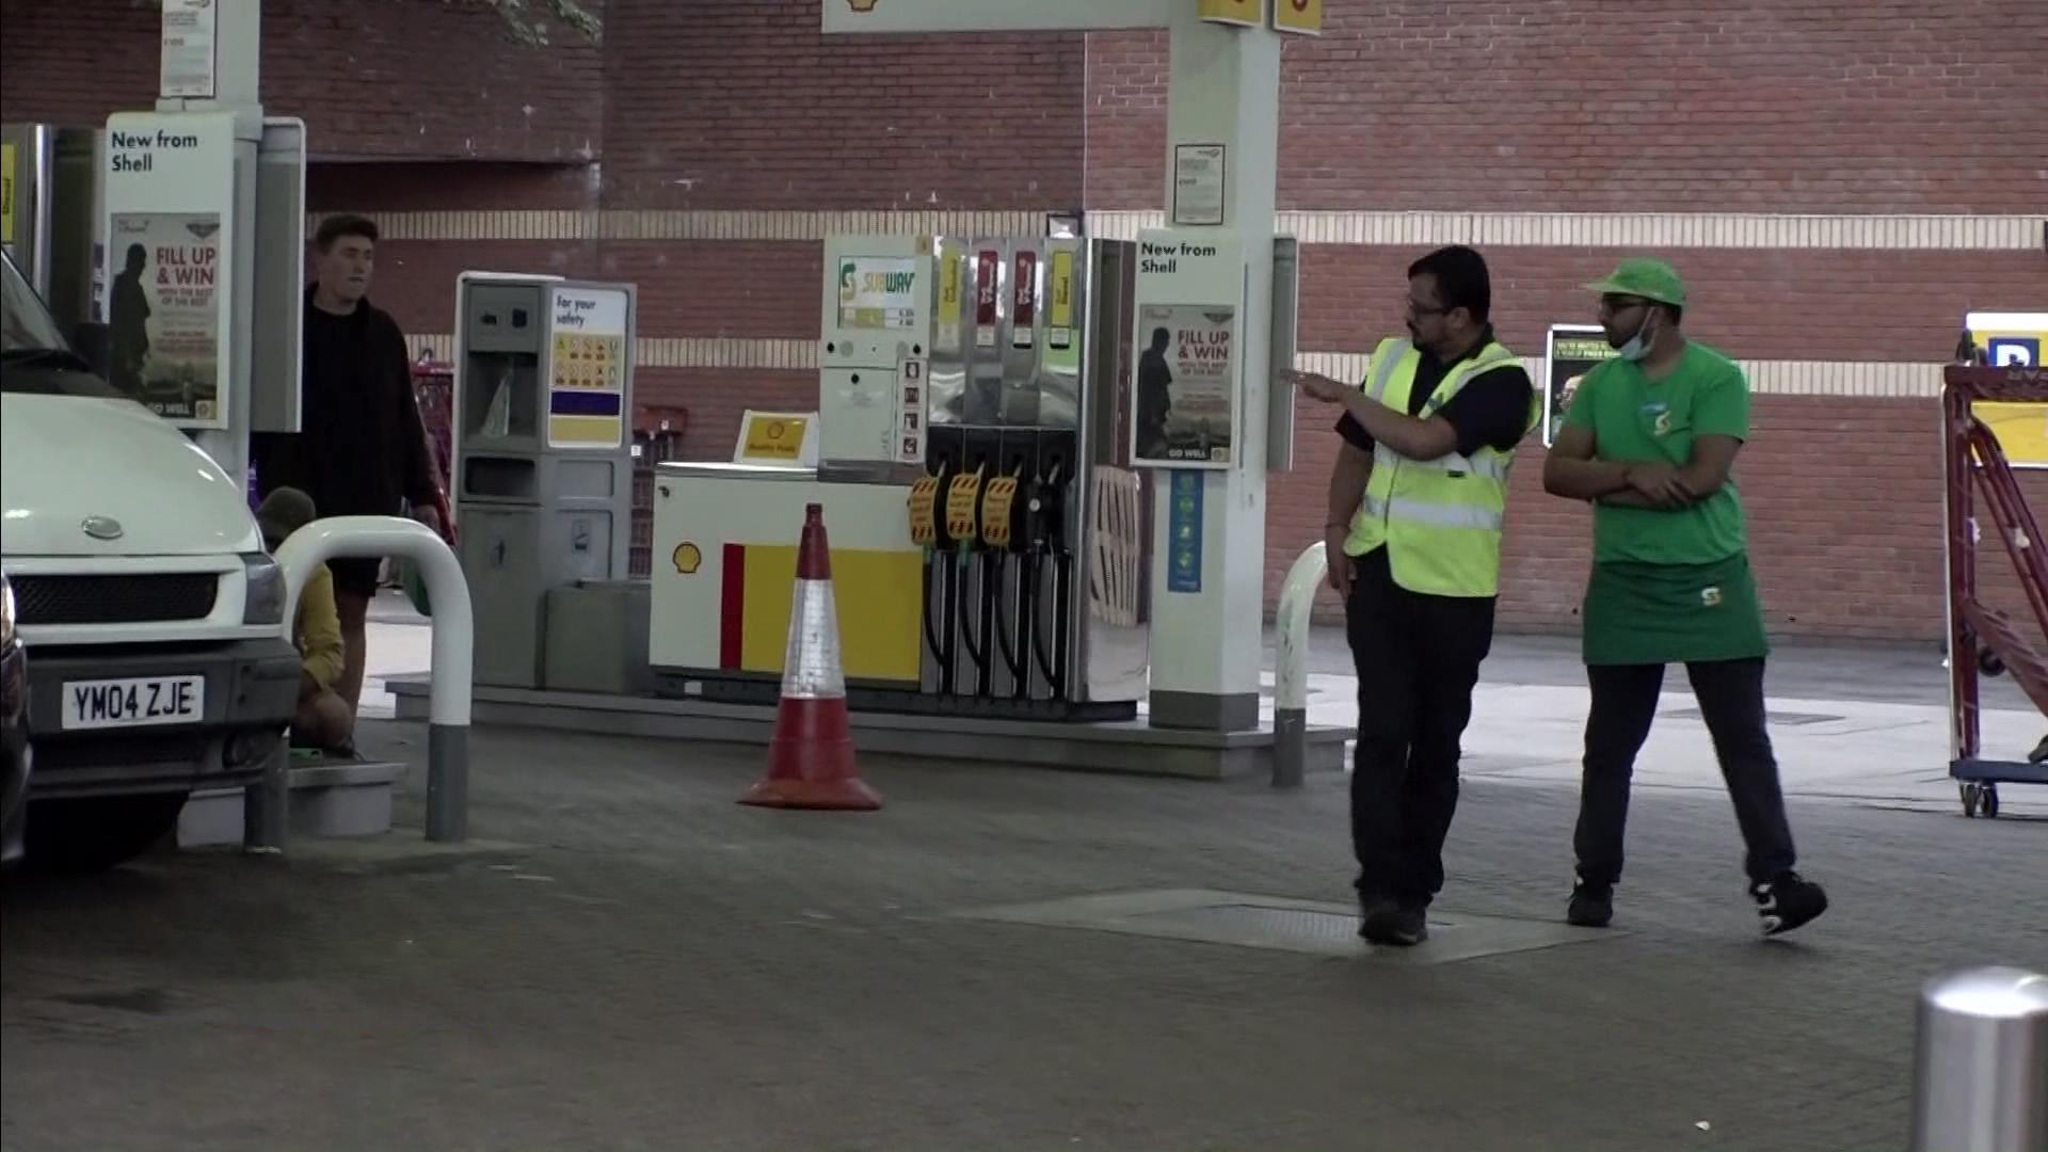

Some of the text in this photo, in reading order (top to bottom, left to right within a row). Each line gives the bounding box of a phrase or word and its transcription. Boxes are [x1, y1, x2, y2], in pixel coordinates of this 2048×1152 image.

[111, 129, 198, 148] New from
[111, 153, 153, 172] Shell
[156, 247, 216, 264] FILL UP
[1140, 240, 1216, 256] New from
[1140, 258, 1177, 273] Shell
[156, 268, 215, 284] & WIN
[862, 271, 915, 293] SUBWAY
[556, 294, 596, 312] For your
[556, 313, 585, 328] safety
[1178, 330, 1230, 344] FILL UP
[1178, 345, 1228, 359] & WIN
[75, 681, 193, 721] YM04 ZJE
